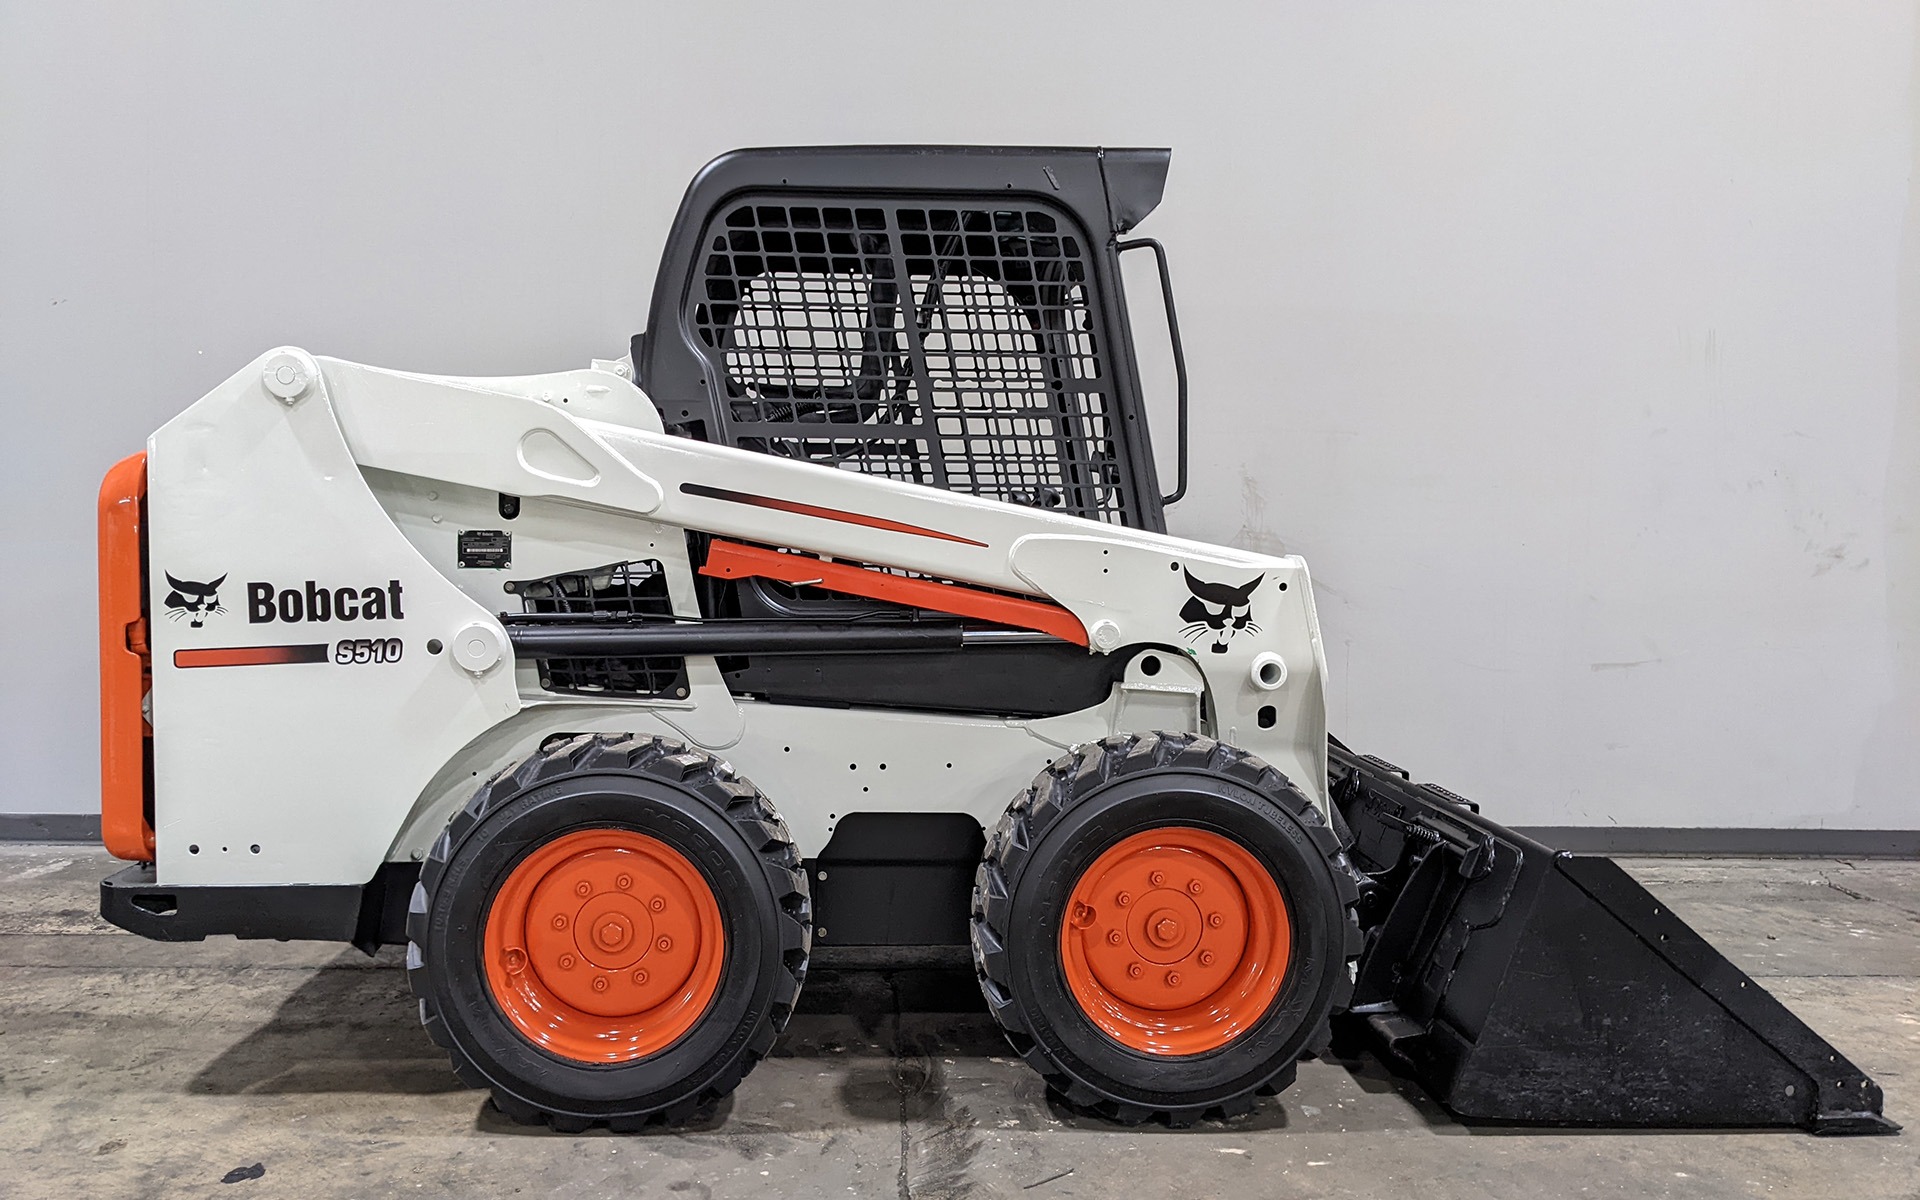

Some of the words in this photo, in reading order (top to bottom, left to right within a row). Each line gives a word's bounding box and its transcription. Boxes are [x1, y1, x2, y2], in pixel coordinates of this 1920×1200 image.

[247, 580, 404, 623] Bobcat
[335, 638, 403, 664] S510
[1258, 801, 1303, 845] TUBELESS
